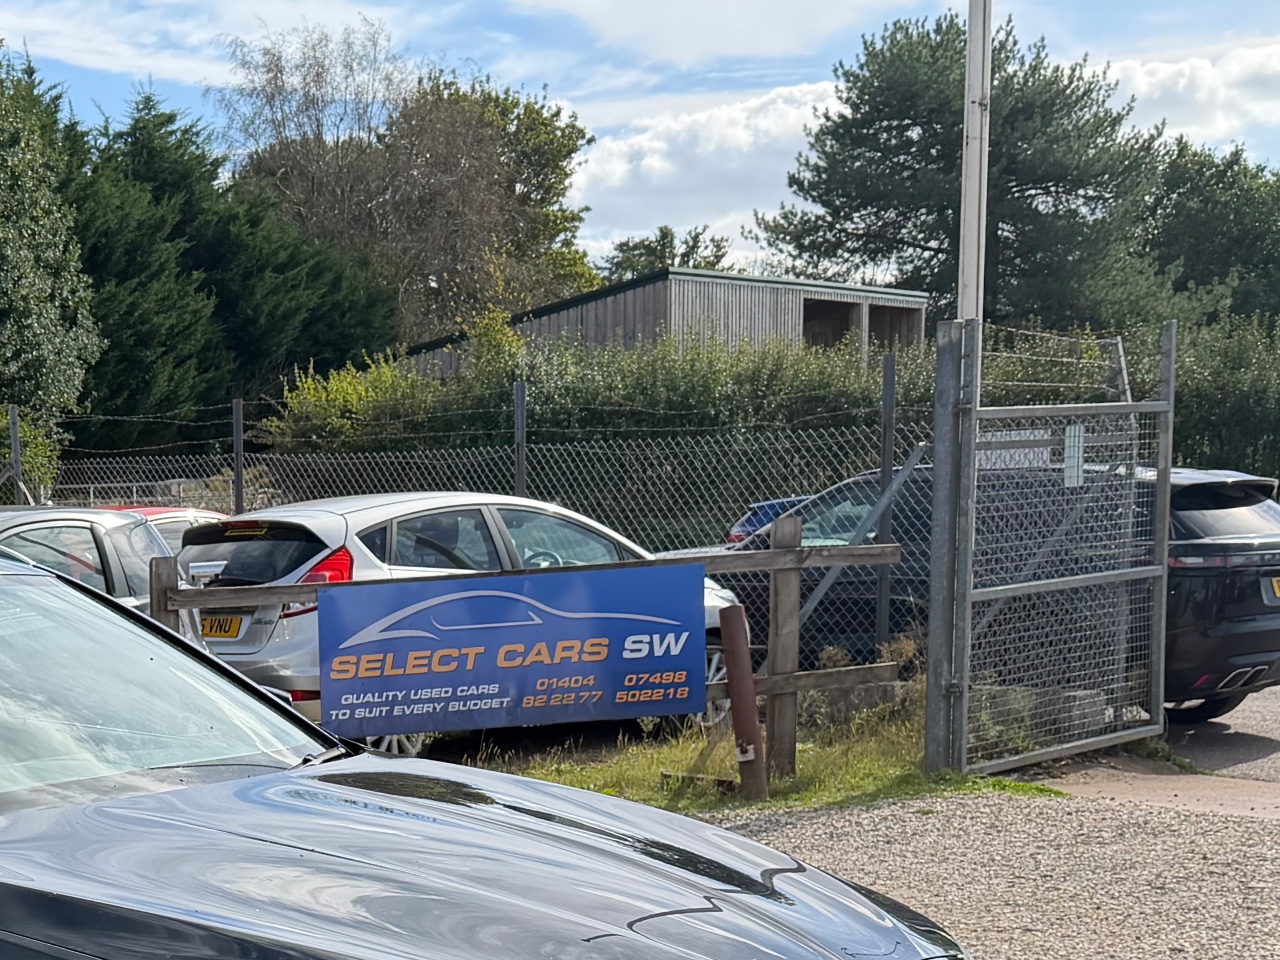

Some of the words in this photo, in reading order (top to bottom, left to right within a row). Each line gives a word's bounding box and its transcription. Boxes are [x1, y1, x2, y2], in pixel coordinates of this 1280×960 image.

[209, 617, 233, 634] VNU
[329, 646, 486, 681] SELECT
[495, 637, 609, 668] CARS
[622, 631, 690, 660] SW
[536, 674, 595, 691] 01404
[624, 671, 688, 687] 07498
[341, 690, 407, 705] QUALITY
[410, 687, 452, 700] USED
[456, 684, 500, 697] CARS
[614, 687, 690, 703] 502218
[329, 709, 351, 721] TO
[354, 706, 390, 719] SUIT
[393, 702, 445, 716] EVERY
[448, 697, 512, 712] BUDGET
